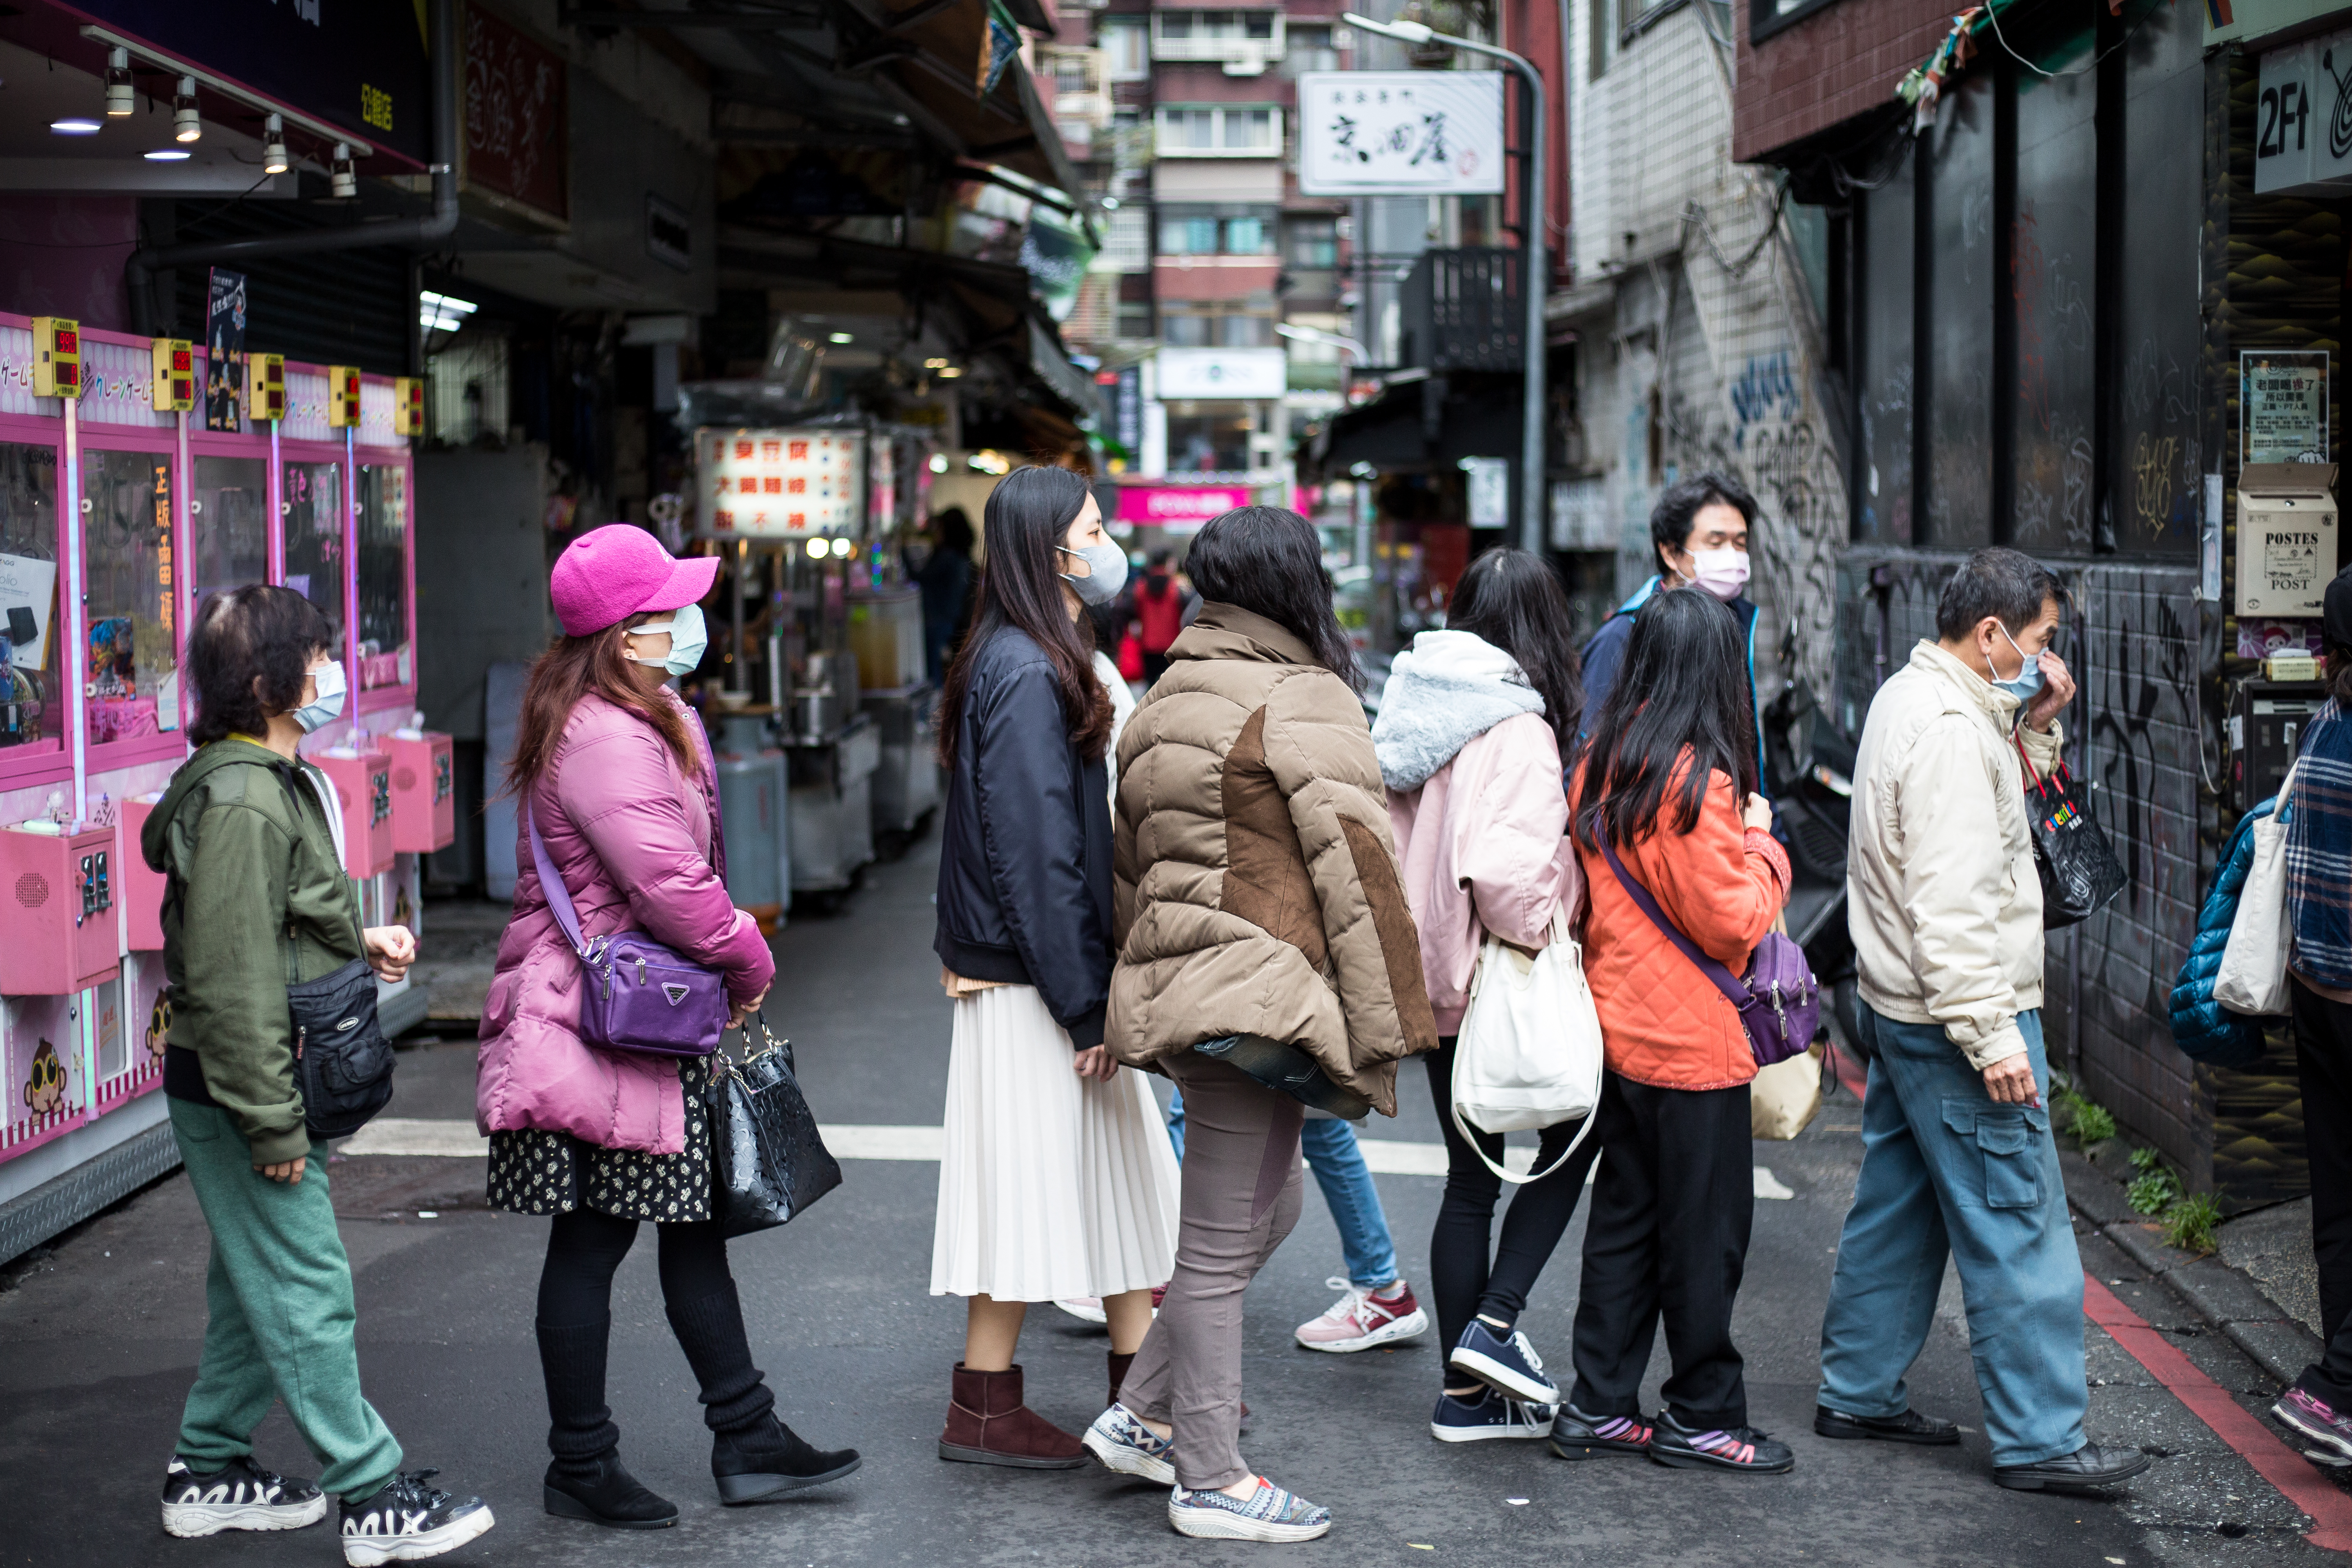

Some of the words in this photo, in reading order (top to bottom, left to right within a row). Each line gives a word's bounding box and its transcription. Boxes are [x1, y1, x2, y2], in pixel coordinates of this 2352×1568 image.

[2258, 82, 2297, 158] 2F
[60, 332, 76, 353] 990
[2266, 532, 2318, 545] POSTES
[2272, 579, 2310, 590] POST
